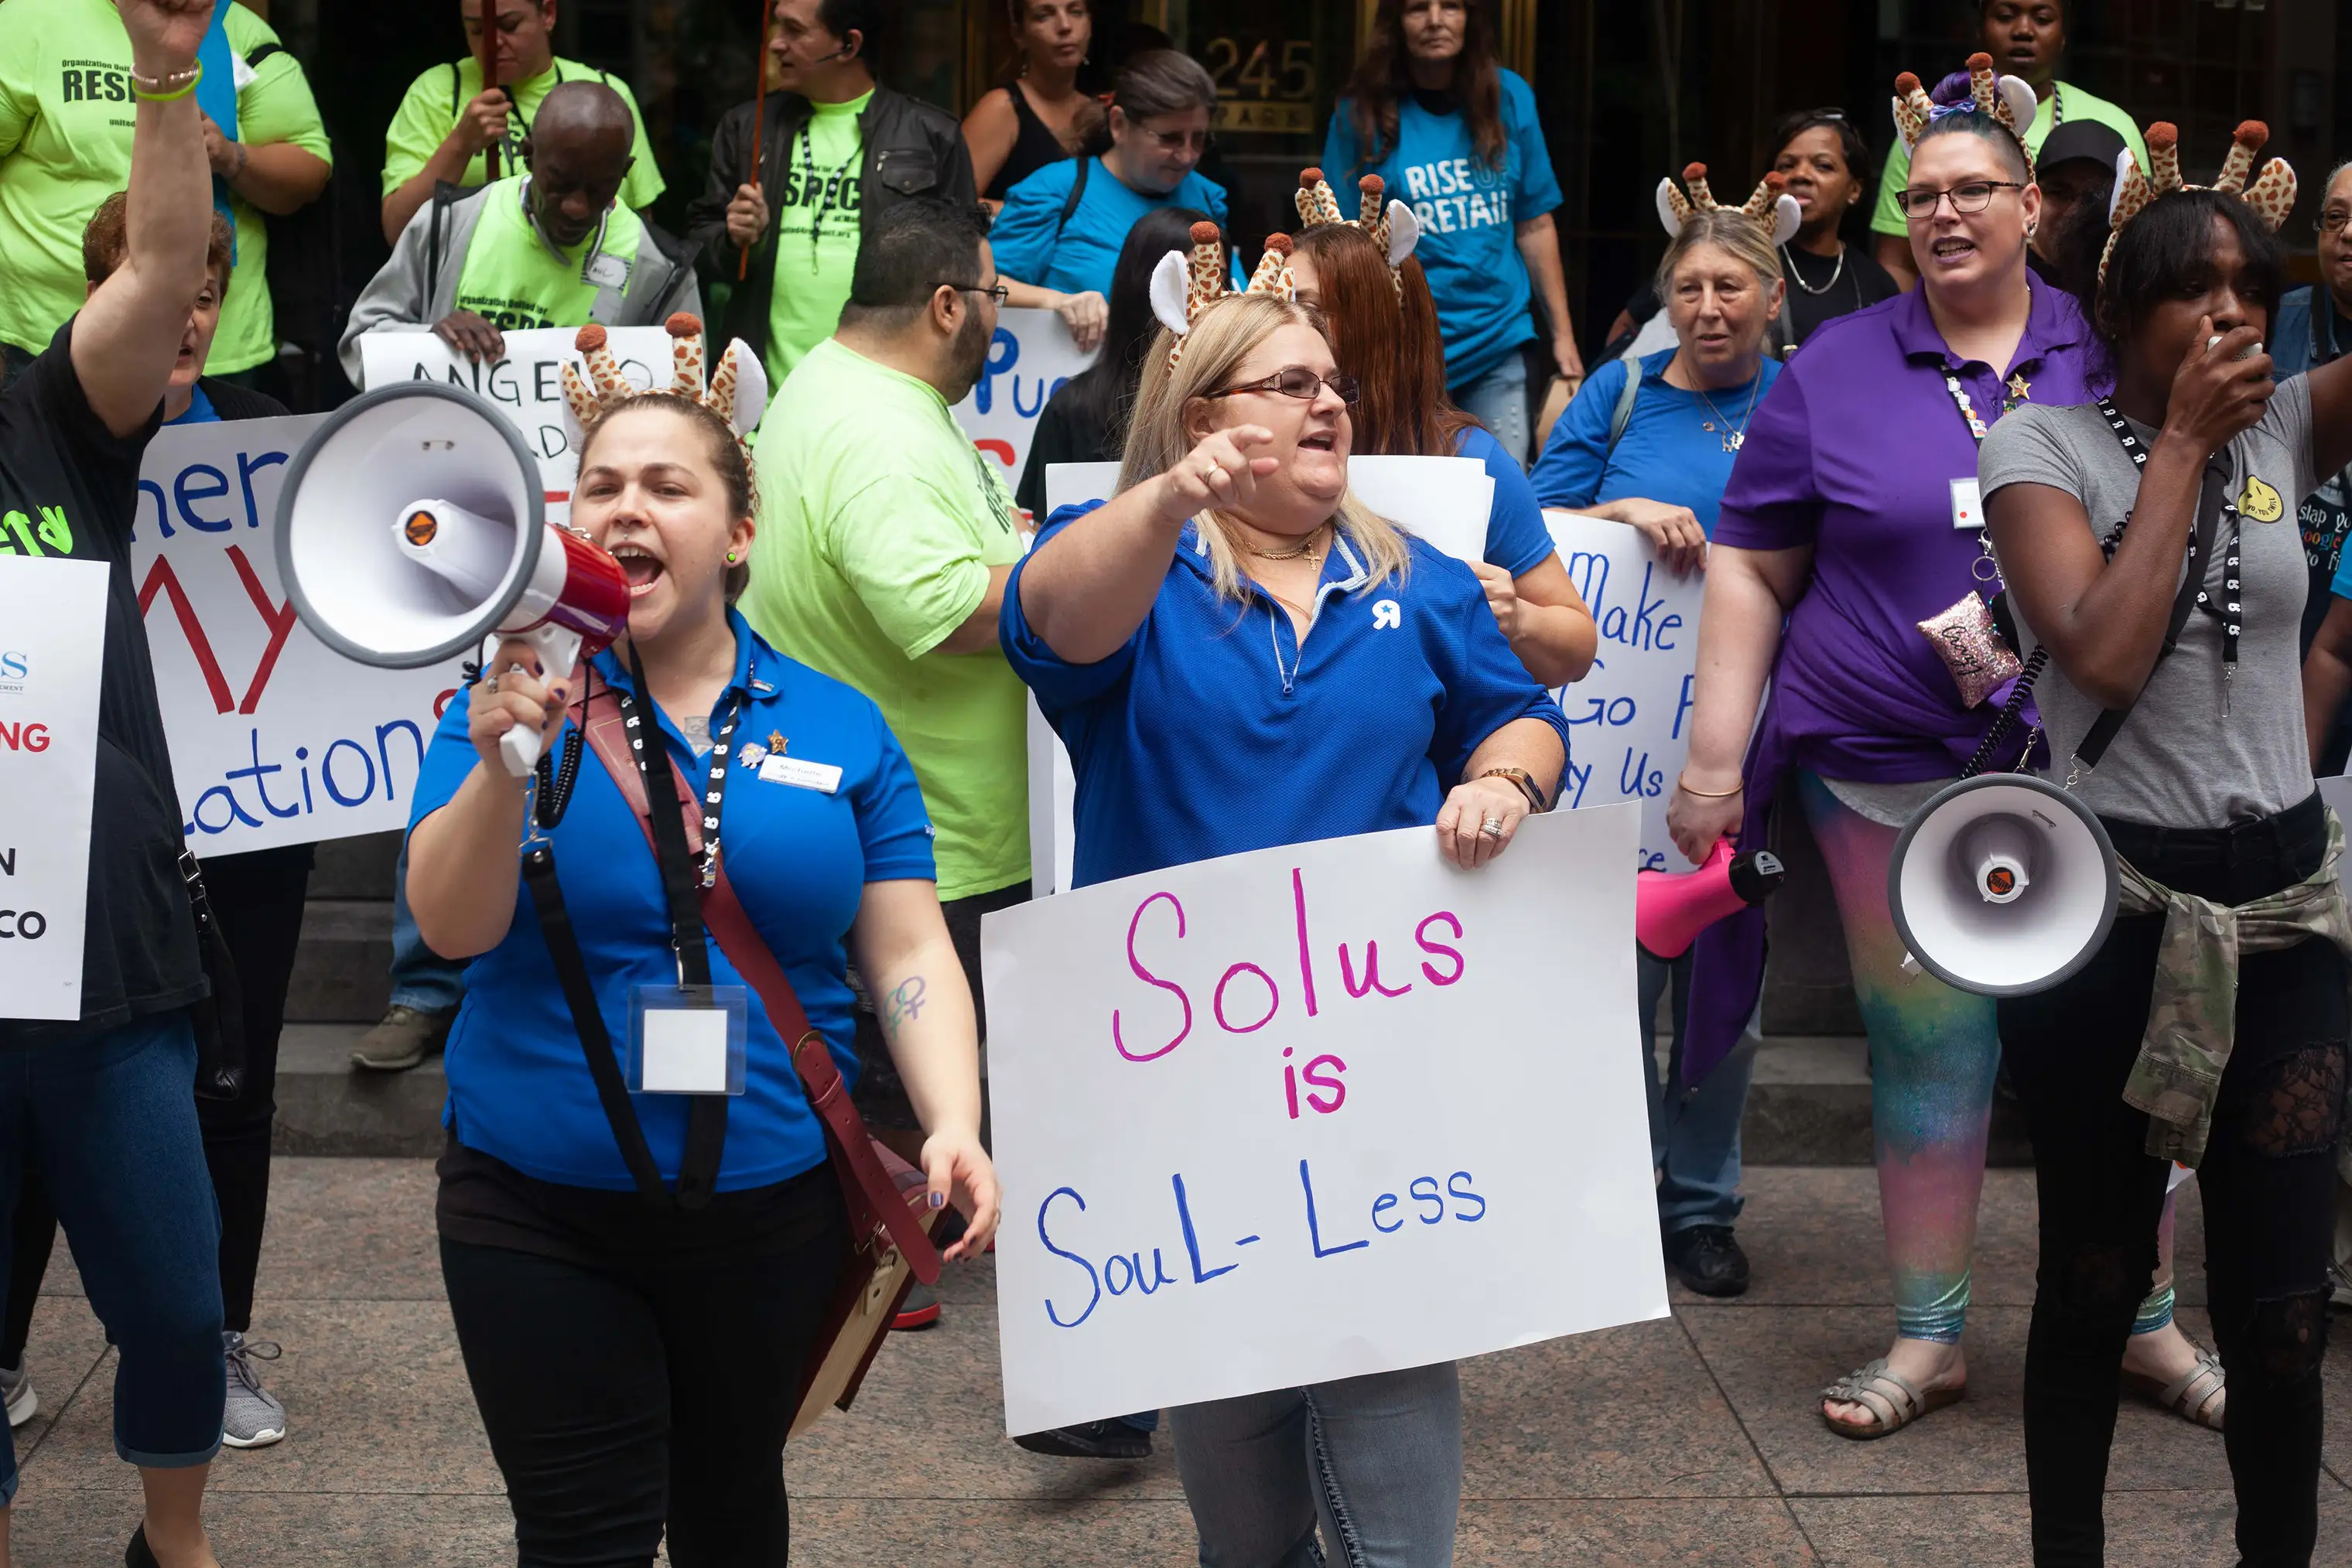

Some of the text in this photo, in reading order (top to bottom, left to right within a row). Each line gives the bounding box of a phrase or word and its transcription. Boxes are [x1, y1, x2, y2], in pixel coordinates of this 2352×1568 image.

[62, 59, 112, 69] Organization
[1206, 37, 1316, 98] 245
[1404, 158, 1474, 200] RISE
[2298, 504, 2326, 528] slap
[0, 721, 50, 753] NG
[184, 719, 425, 835] ation
[1621, 746, 1663, 797] Us
[1113, 867, 1465, 1062] Solus
[1284, 1047, 1347, 1119] is
[1300, 1159, 1488, 1258] Less
